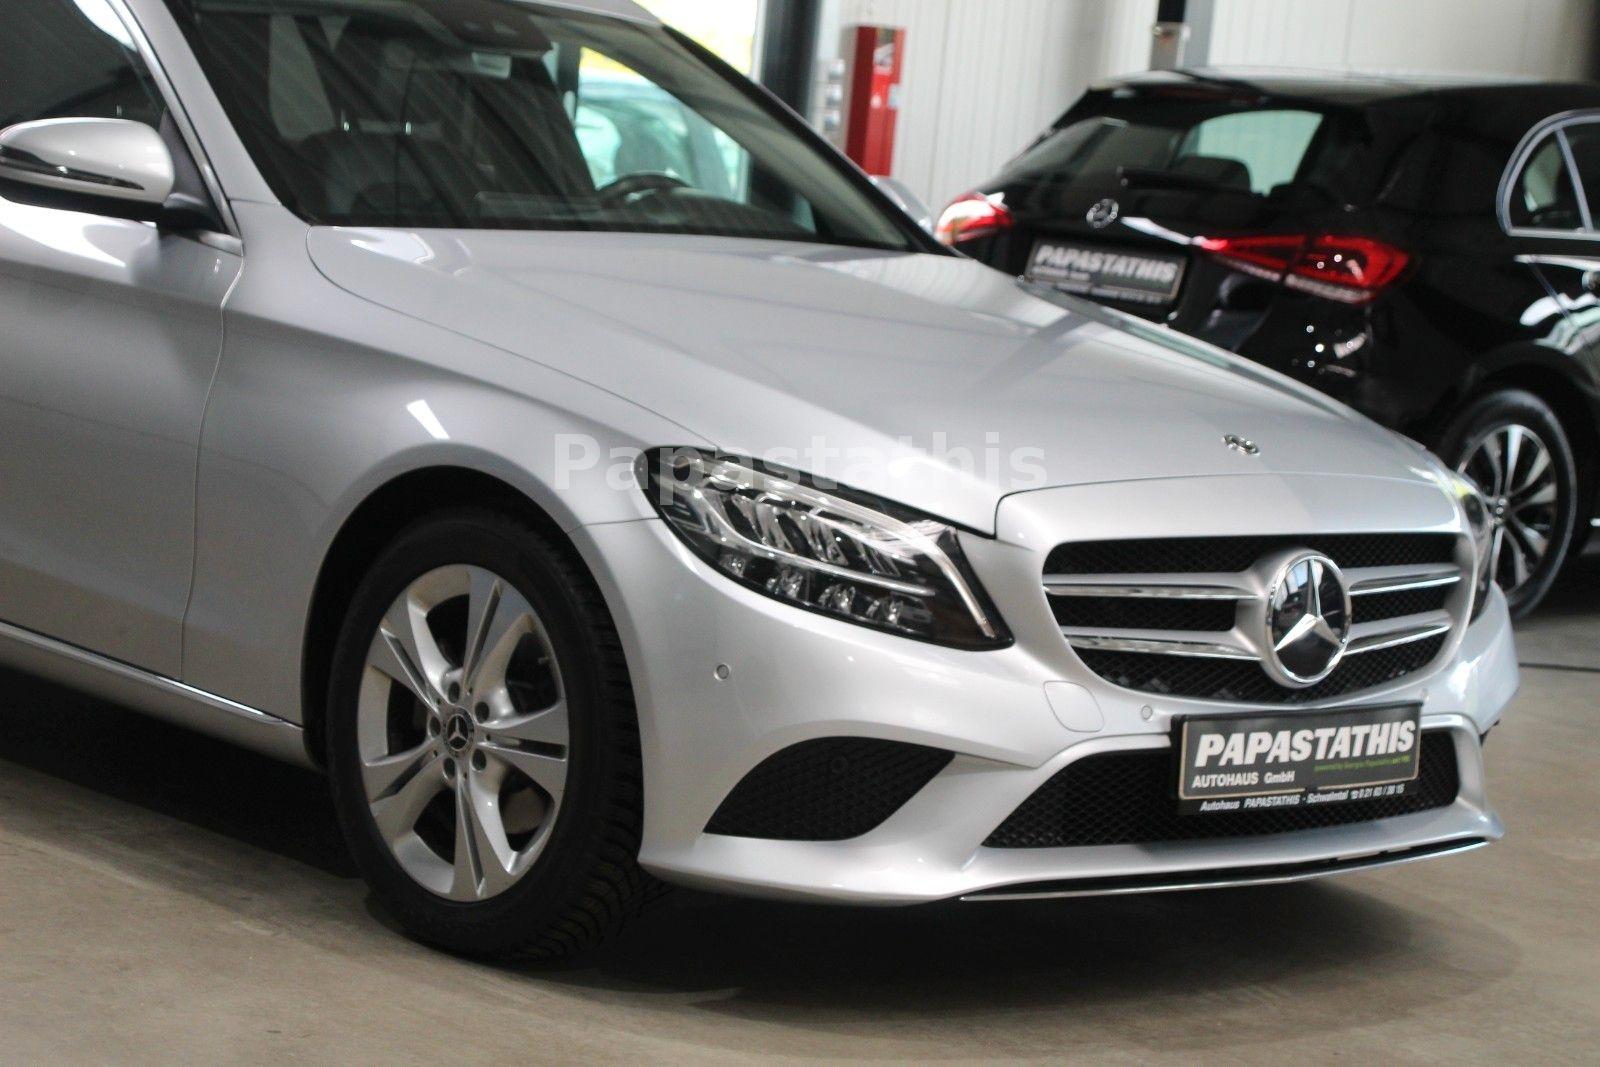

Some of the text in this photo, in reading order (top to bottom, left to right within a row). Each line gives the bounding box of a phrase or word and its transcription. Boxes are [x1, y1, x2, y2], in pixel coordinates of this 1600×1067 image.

[1034, 245, 1178, 282] PAPASTATHIS
[1194, 720, 1416, 768] PAPASTATHIS
[1193, 771, 1295, 788] AUTOHAUS GmbH
[1200, 801, 1240, 811] Autohaus
[1244, 795, 1301, 808] PAPASTATHIS
